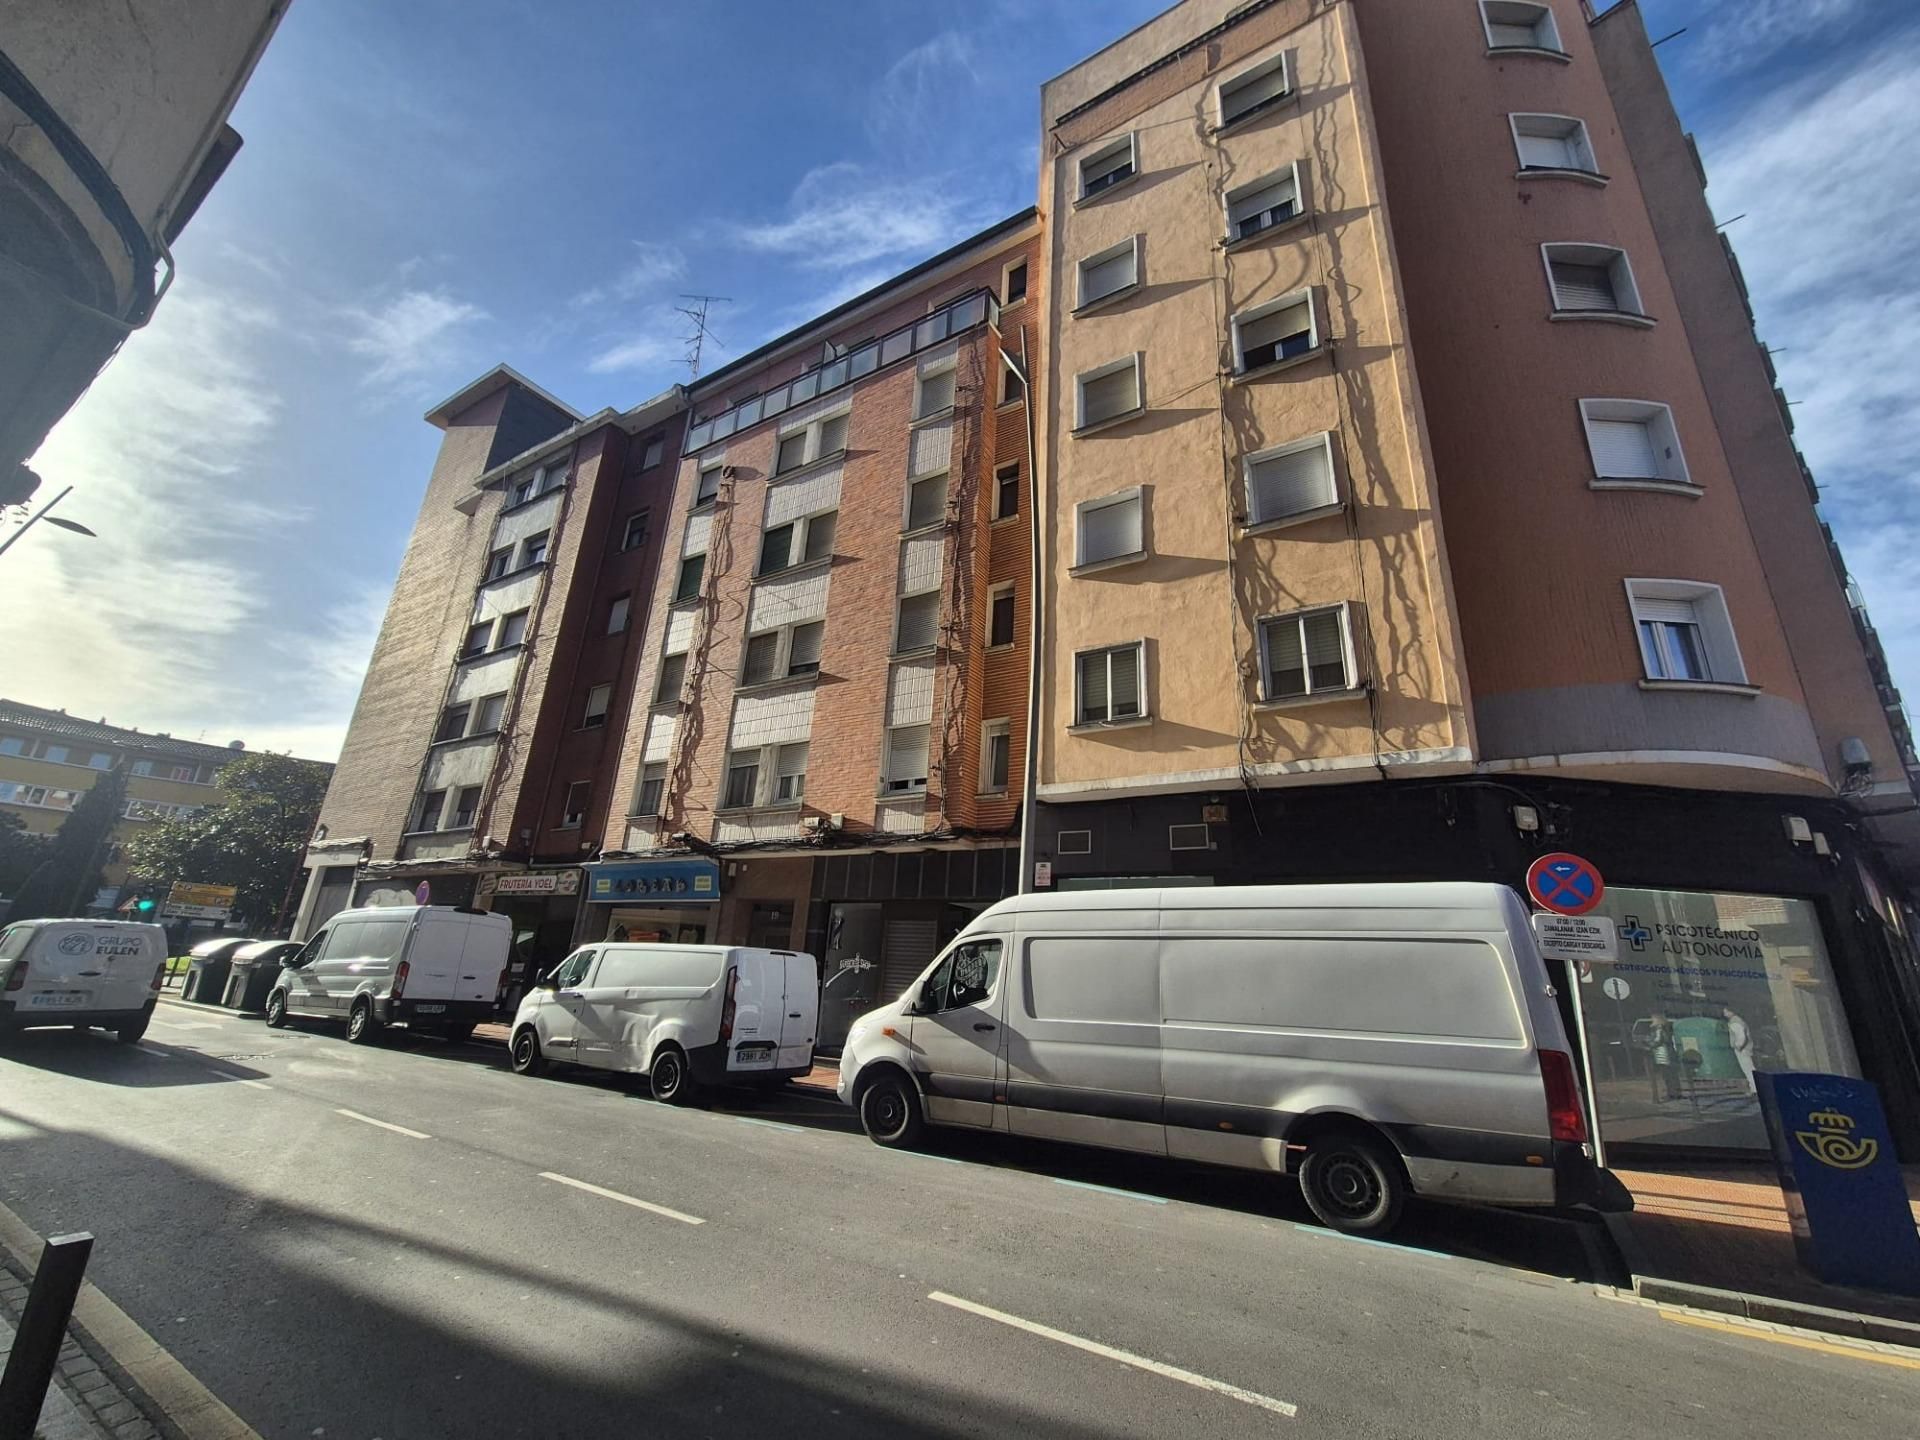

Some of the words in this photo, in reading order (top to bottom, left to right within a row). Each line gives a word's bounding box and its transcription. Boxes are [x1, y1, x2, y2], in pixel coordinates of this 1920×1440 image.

[499, 877, 532, 889] FRUTERÍA
[535, 878, 553, 889] YOEL
[1655, 923, 1760, 942] PSICOTÉCNICO
[97, 936, 141, 947] GRUPO
[1582, 942, 1606, 950] DESCARGA
[95, 946, 139, 956] EULEN
[1662, 939, 1763, 959] AUTONOMÍA
[1613, 962, 1672, 975] CERTIFICADOS
